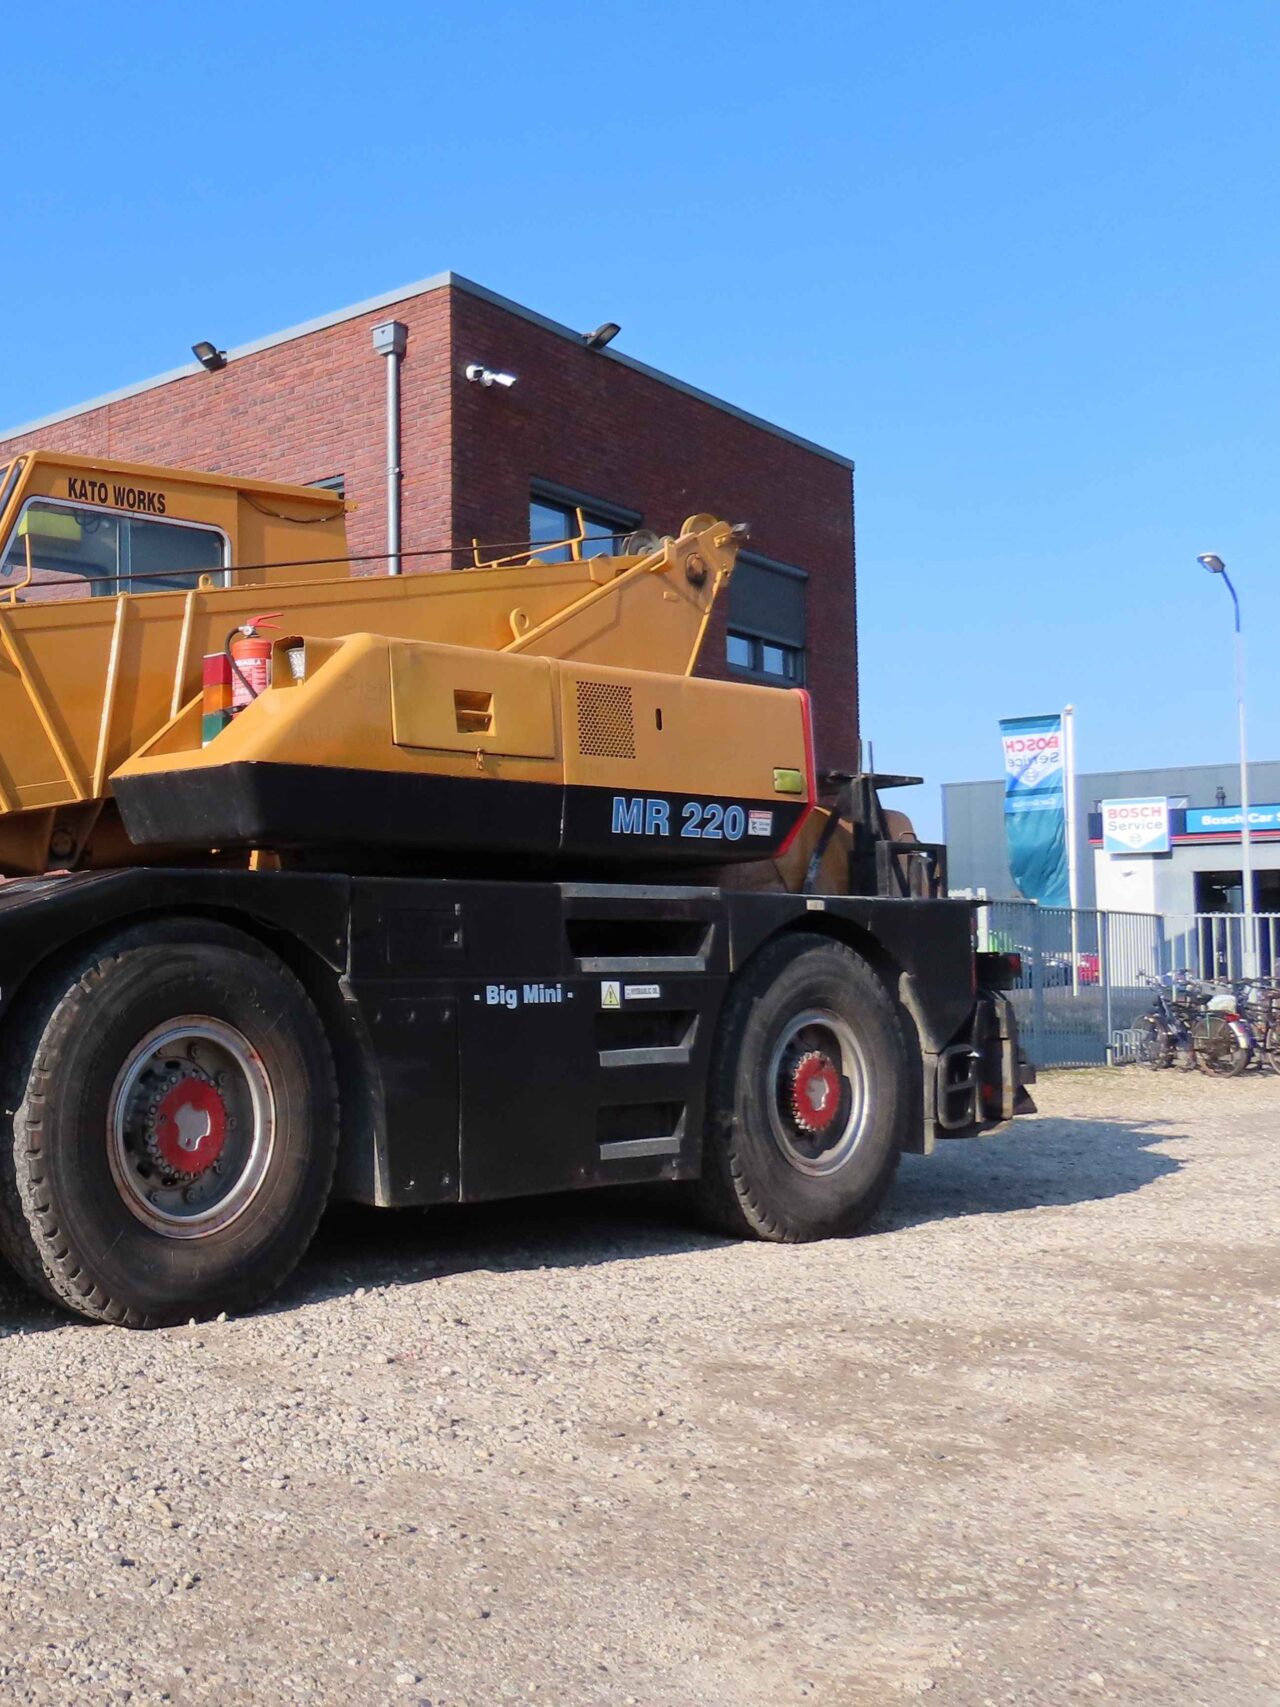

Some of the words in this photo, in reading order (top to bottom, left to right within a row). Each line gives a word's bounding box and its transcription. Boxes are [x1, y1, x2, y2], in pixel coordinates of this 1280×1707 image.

[68, 477, 108, 504] KATO
[113, 485, 166, 514] WORKS
[611, 796, 670, 836] MR
[681, 802, 745, 840] 220
[1107, 806, 1162, 820] BOSCH
[1201, 814, 1243, 825] Bosch
[1248, 812, 1273, 823] Car
[1108, 820, 1163, 831] Service
[486, 985, 518, 1009] Big
[523, 983, 562, 1003] Mini
